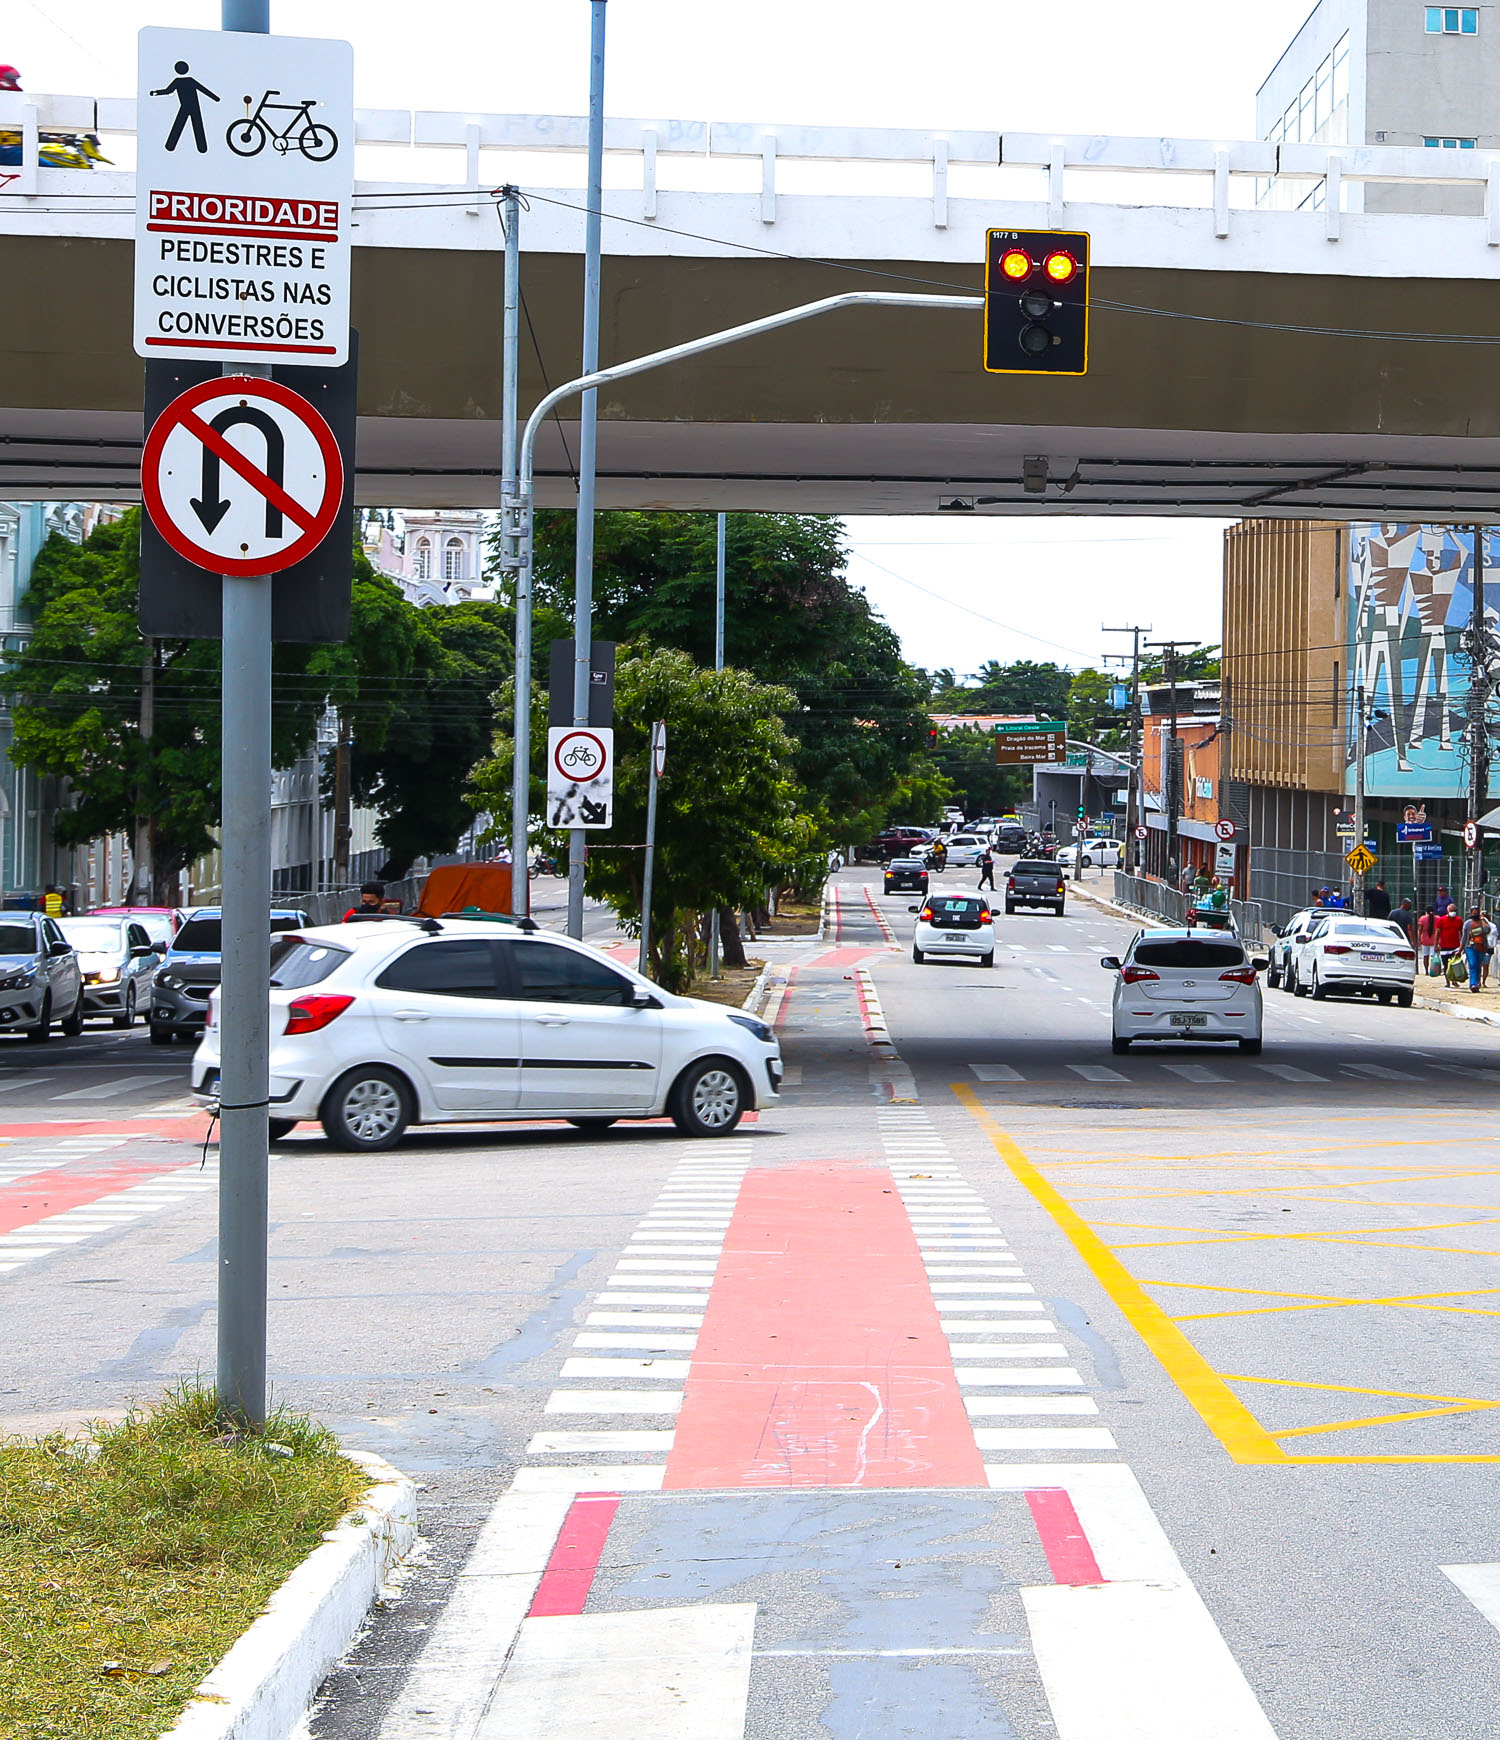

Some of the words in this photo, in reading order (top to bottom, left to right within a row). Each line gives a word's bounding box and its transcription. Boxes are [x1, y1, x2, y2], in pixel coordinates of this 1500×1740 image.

[150, 193, 338, 228] PRIORIDADE
[992, 231, 1009, 239] 1177
[1011, 232, 1019, 240] B
[160, 239, 304, 269] PEDESTRES
[311, 247, 326, 270] E
[152, 274, 276, 303] CICLISTAS
[283, 281, 332, 306] NAS
[158, 311, 325, 341] CONVERSÕES
